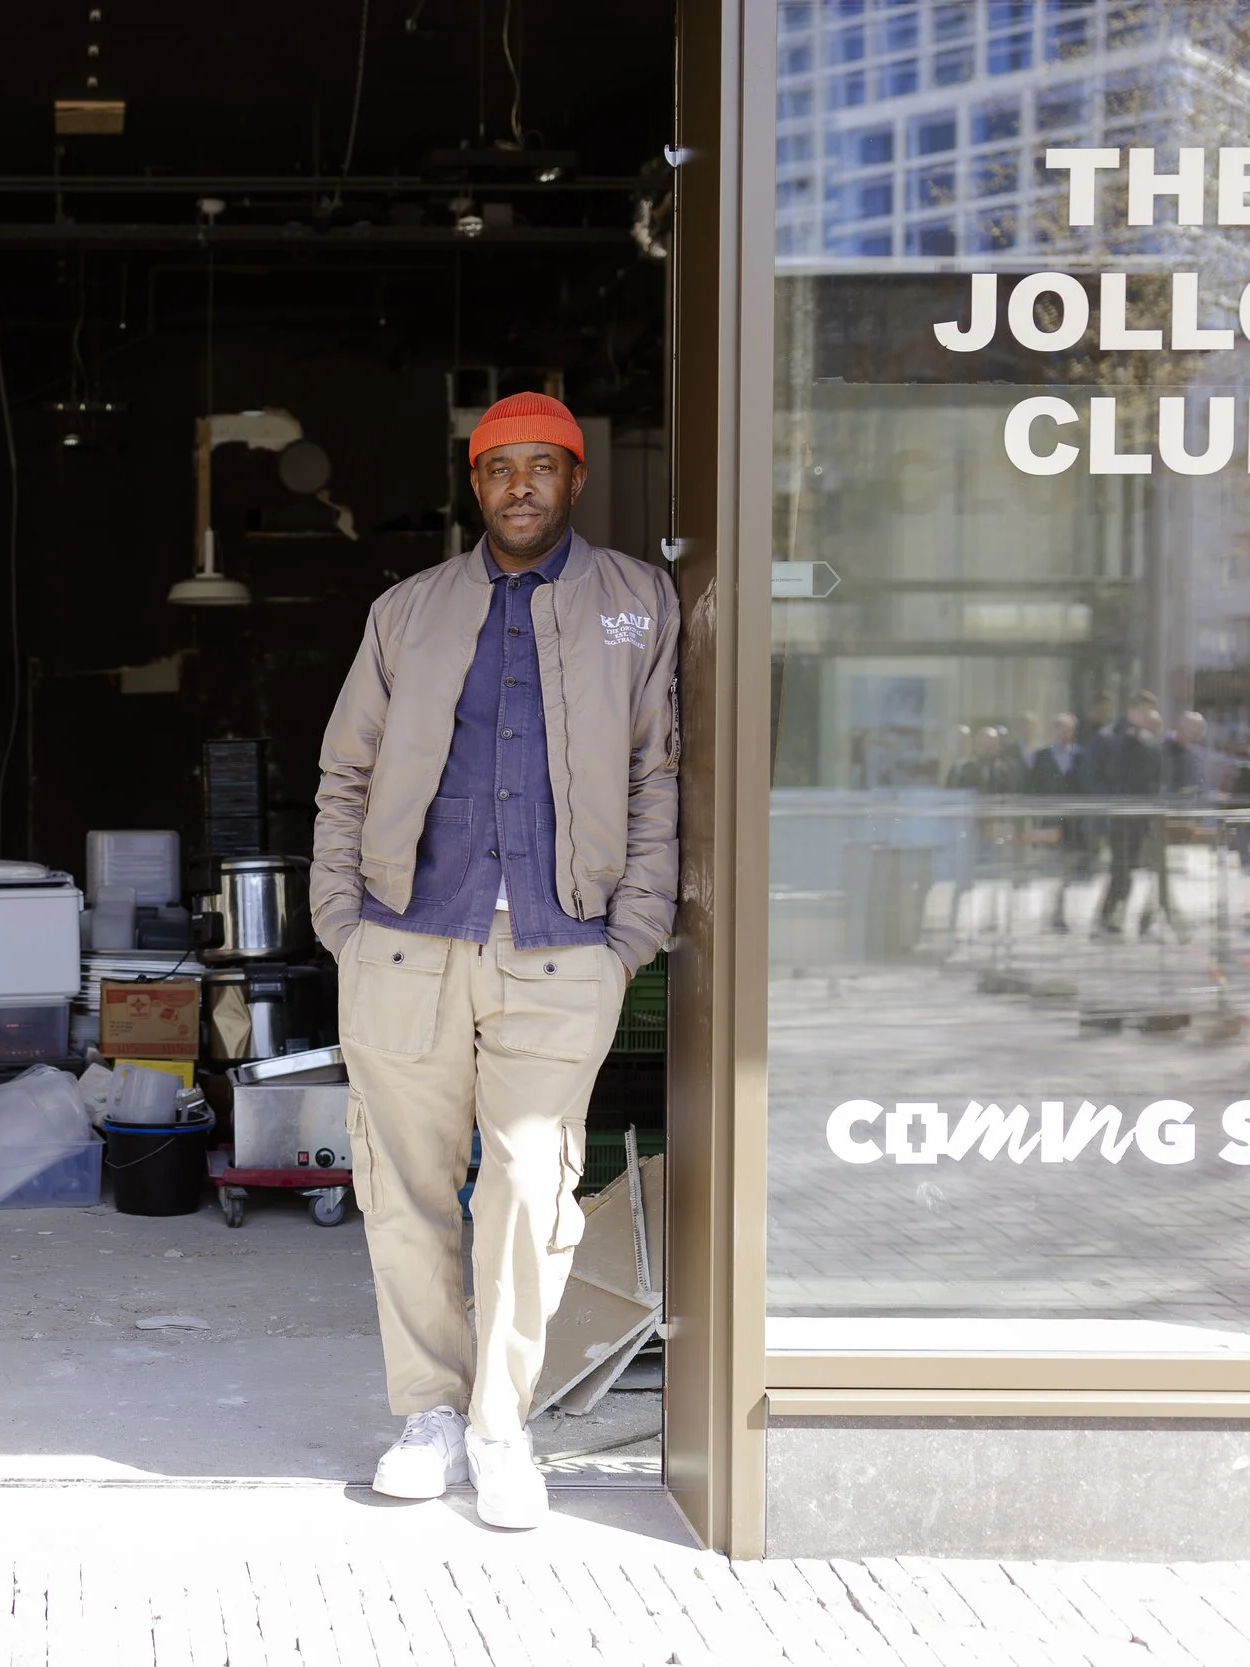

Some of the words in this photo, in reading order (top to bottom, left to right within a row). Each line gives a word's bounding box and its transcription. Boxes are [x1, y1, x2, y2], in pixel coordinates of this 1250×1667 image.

[933, 272, 1250, 352] JOLL
[1004, 396, 1250, 476] CLU
[599, 612, 651, 630] KANI
